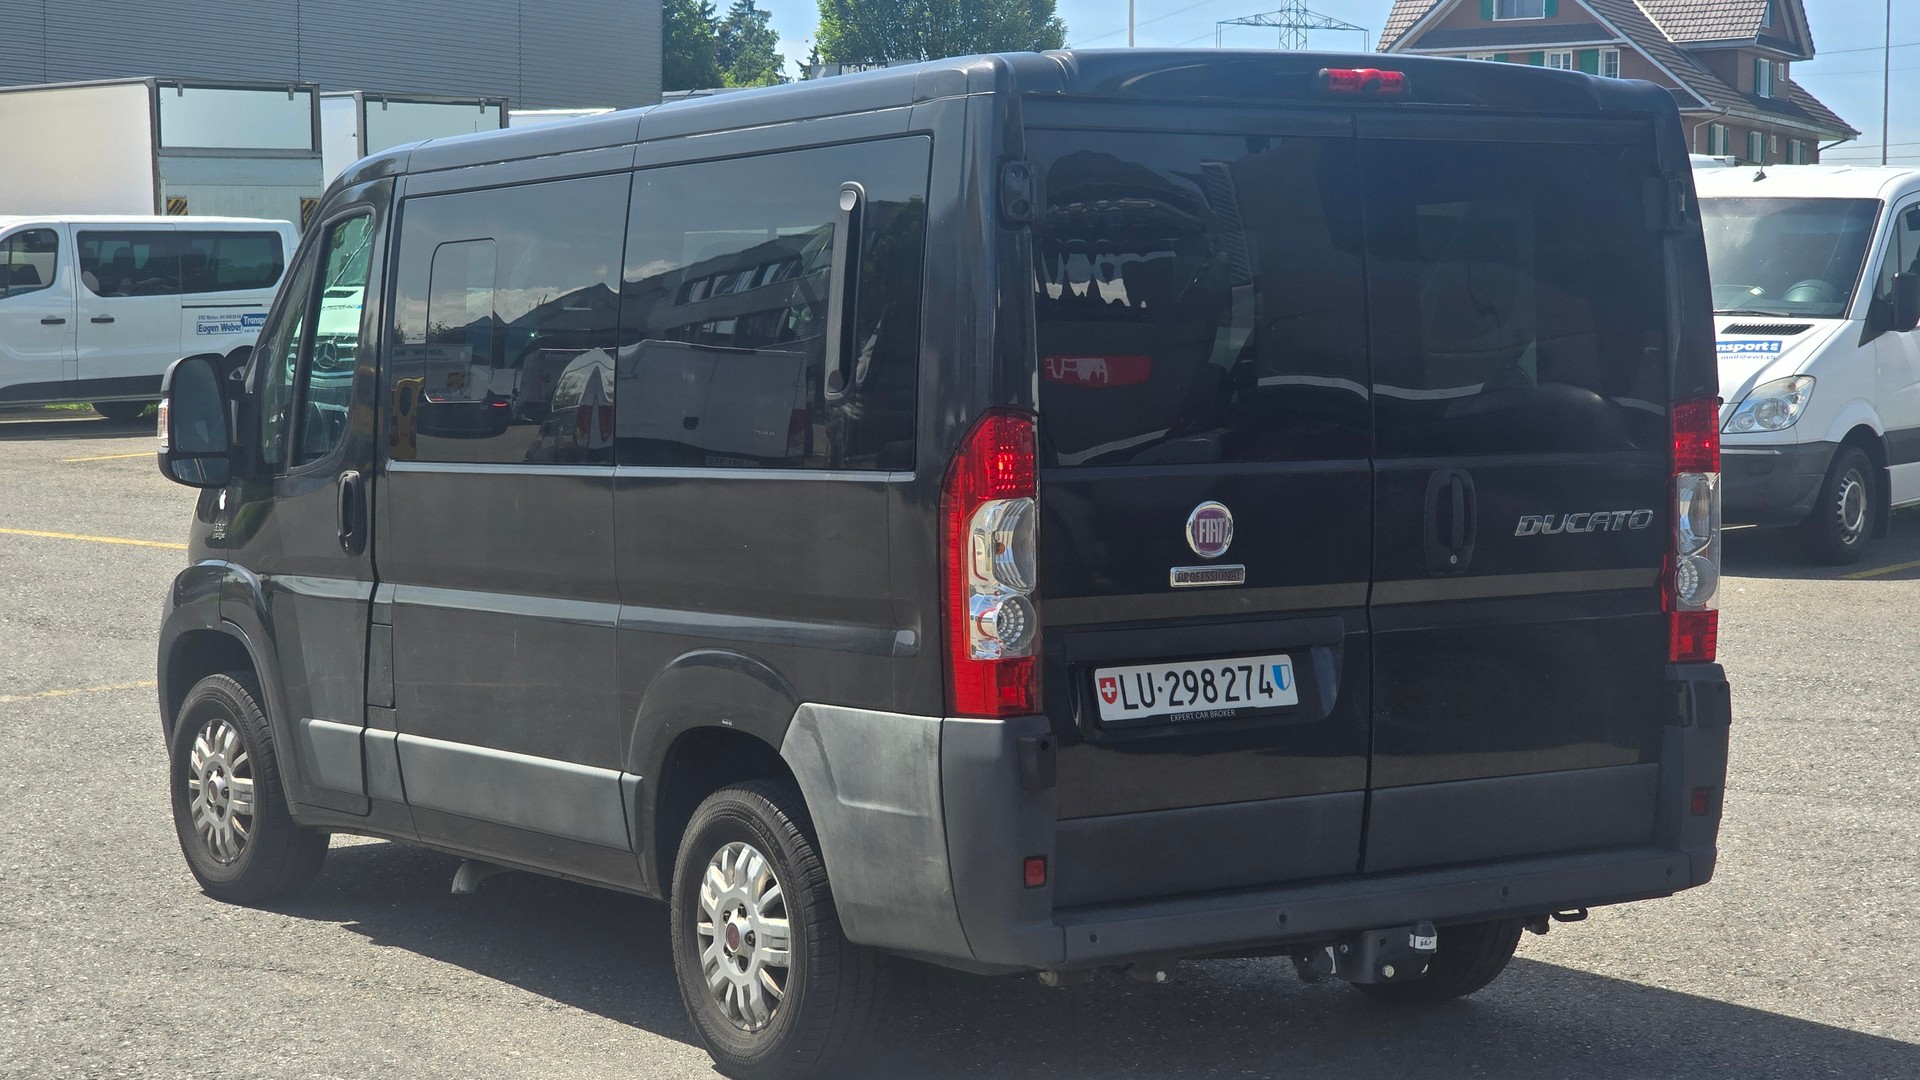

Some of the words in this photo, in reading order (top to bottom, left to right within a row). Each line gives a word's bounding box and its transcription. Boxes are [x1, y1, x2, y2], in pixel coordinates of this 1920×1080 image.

[243, 316, 267, 326] Transp
[198, 324, 219, 334] Eugen
[220, 323, 242, 332] Weber
[1716, 342, 1769, 352] nsport
[1515, 508, 1654, 537] DUCATO
[1199, 518, 1225, 543] FIAT
[1177, 570, 1241, 581] PROFESSIONAL
[1170, 712, 1194, 722] EXPERT
[1196, 711, 1209, 720] CAR
[1210, 709, 1236, 719] BROKER
